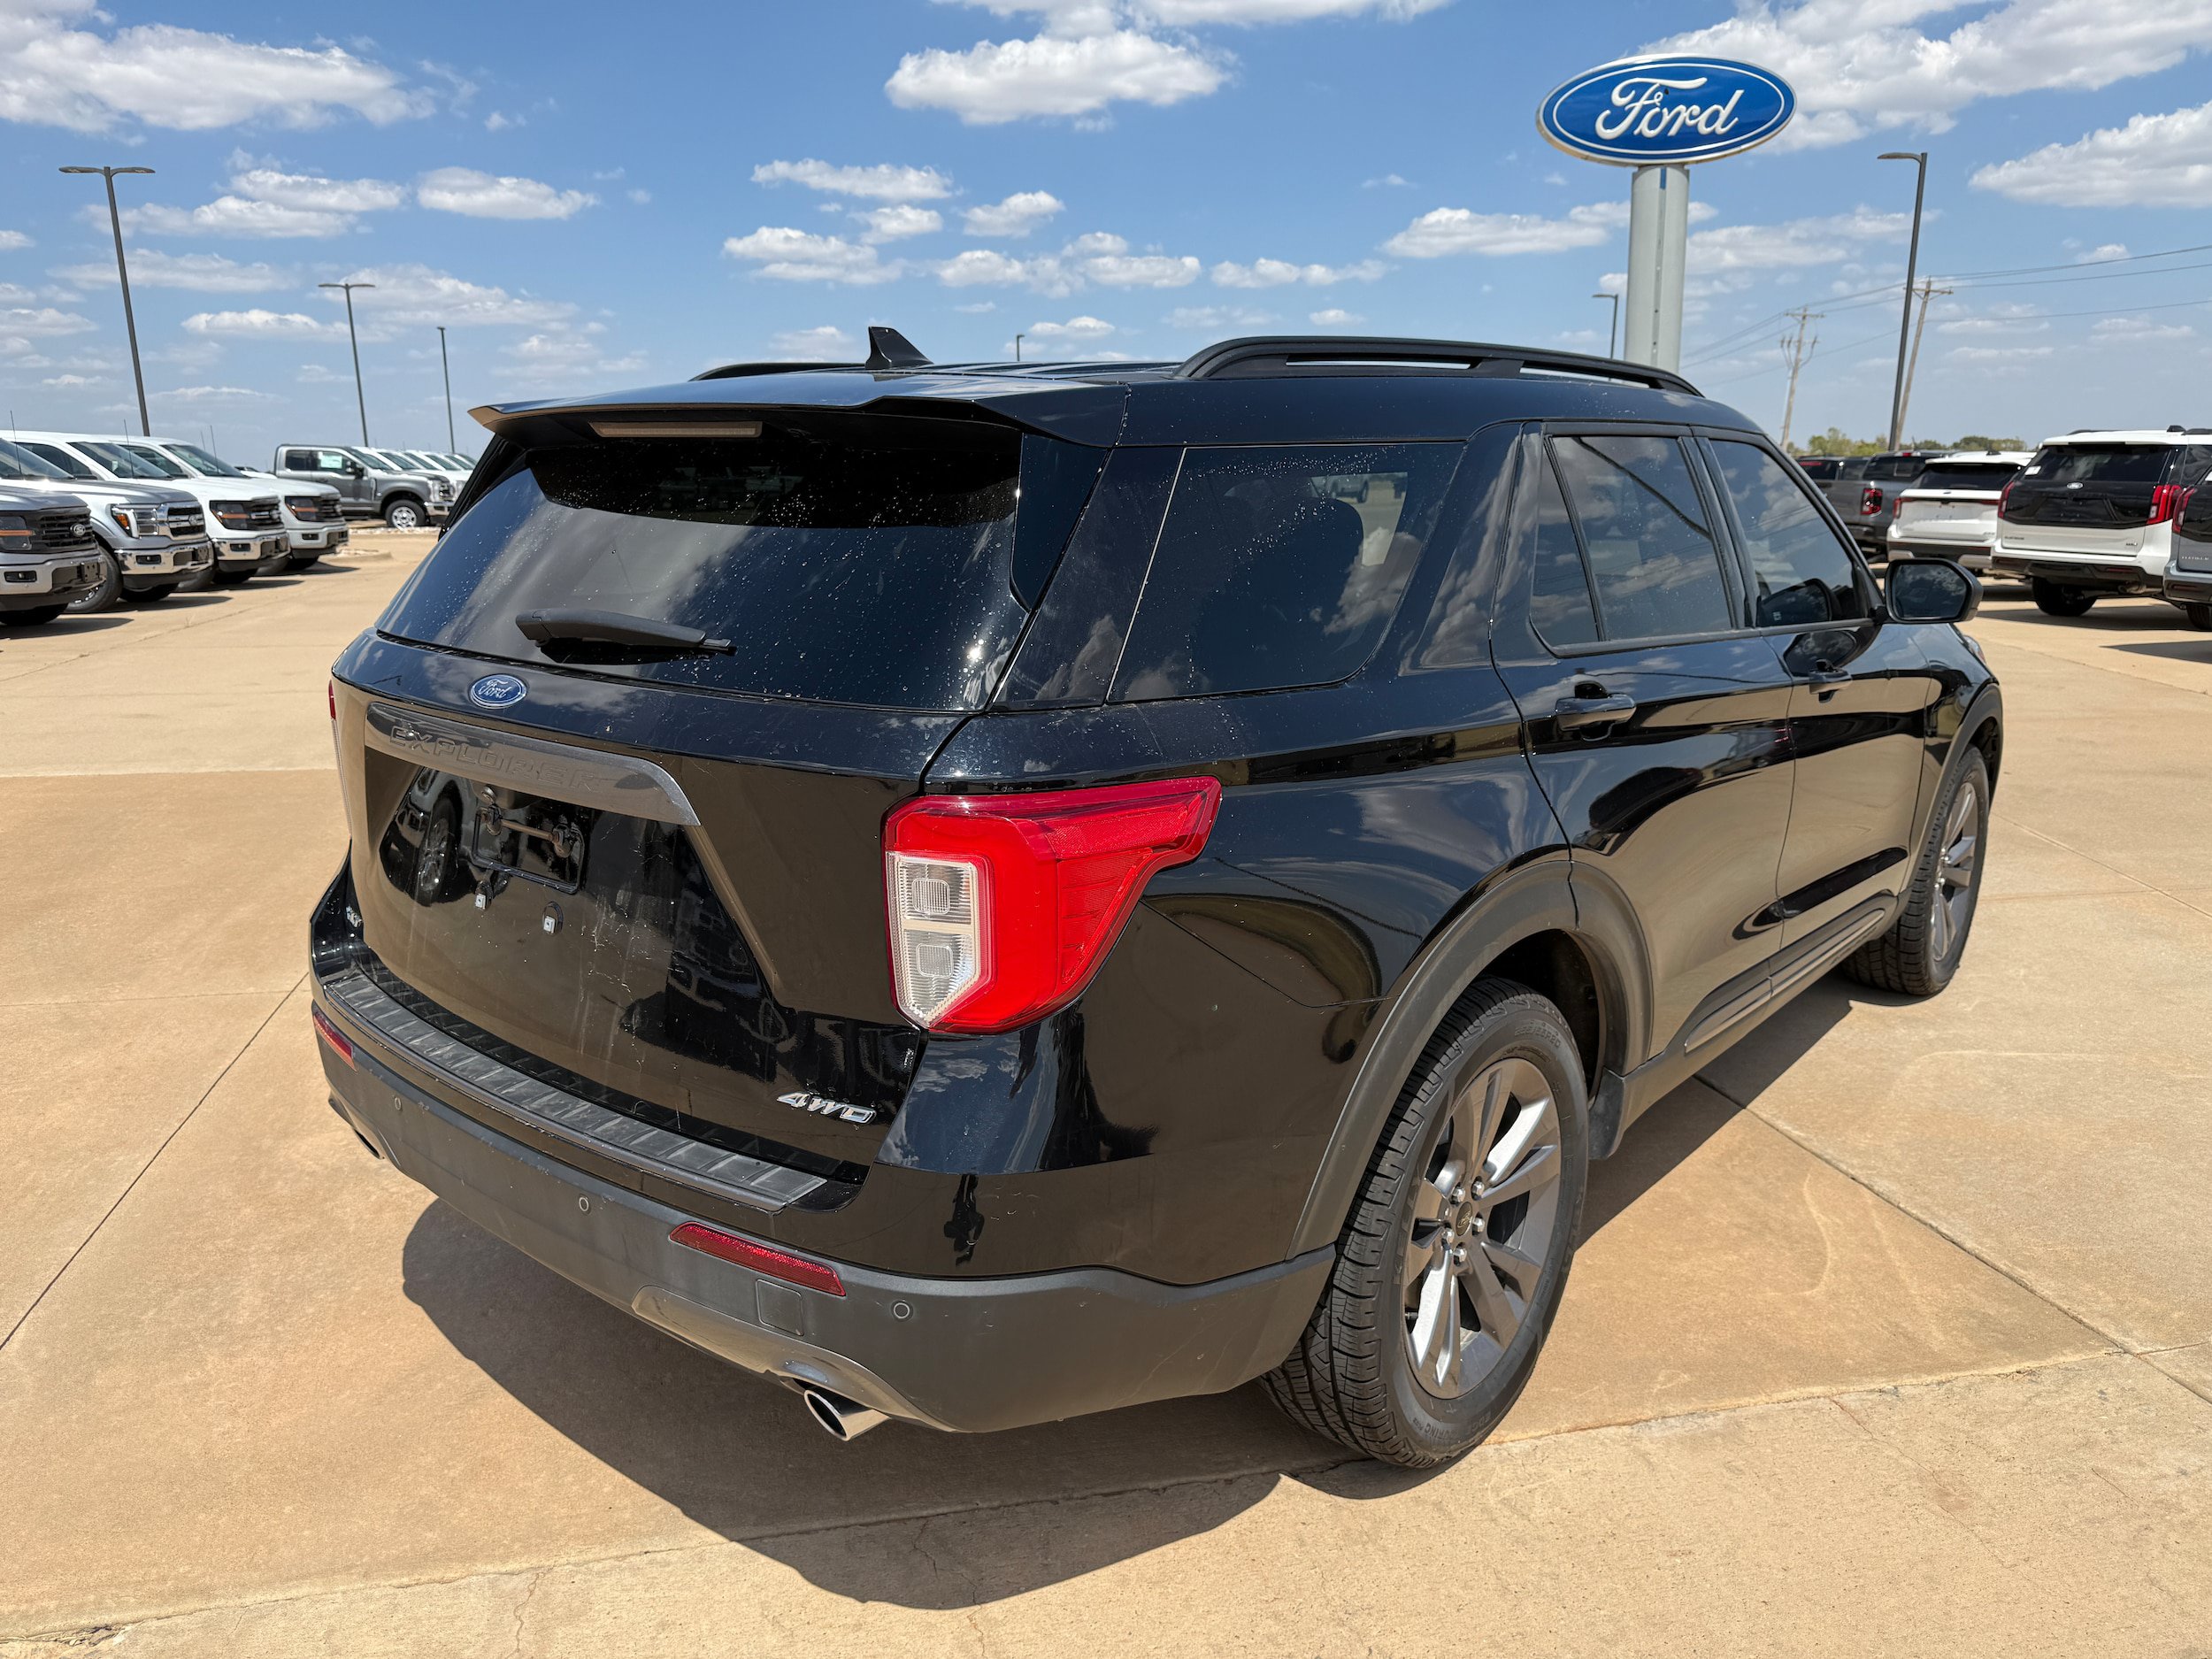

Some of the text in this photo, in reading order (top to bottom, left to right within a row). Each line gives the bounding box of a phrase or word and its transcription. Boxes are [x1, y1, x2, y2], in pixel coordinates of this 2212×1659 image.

[1595, 76, 1745, 140] Ford
[478, 679, 512, 698] Ford
[390, 726, 603, 792] EXPLORER
[776, 1091, 876, 1124] 4WD
